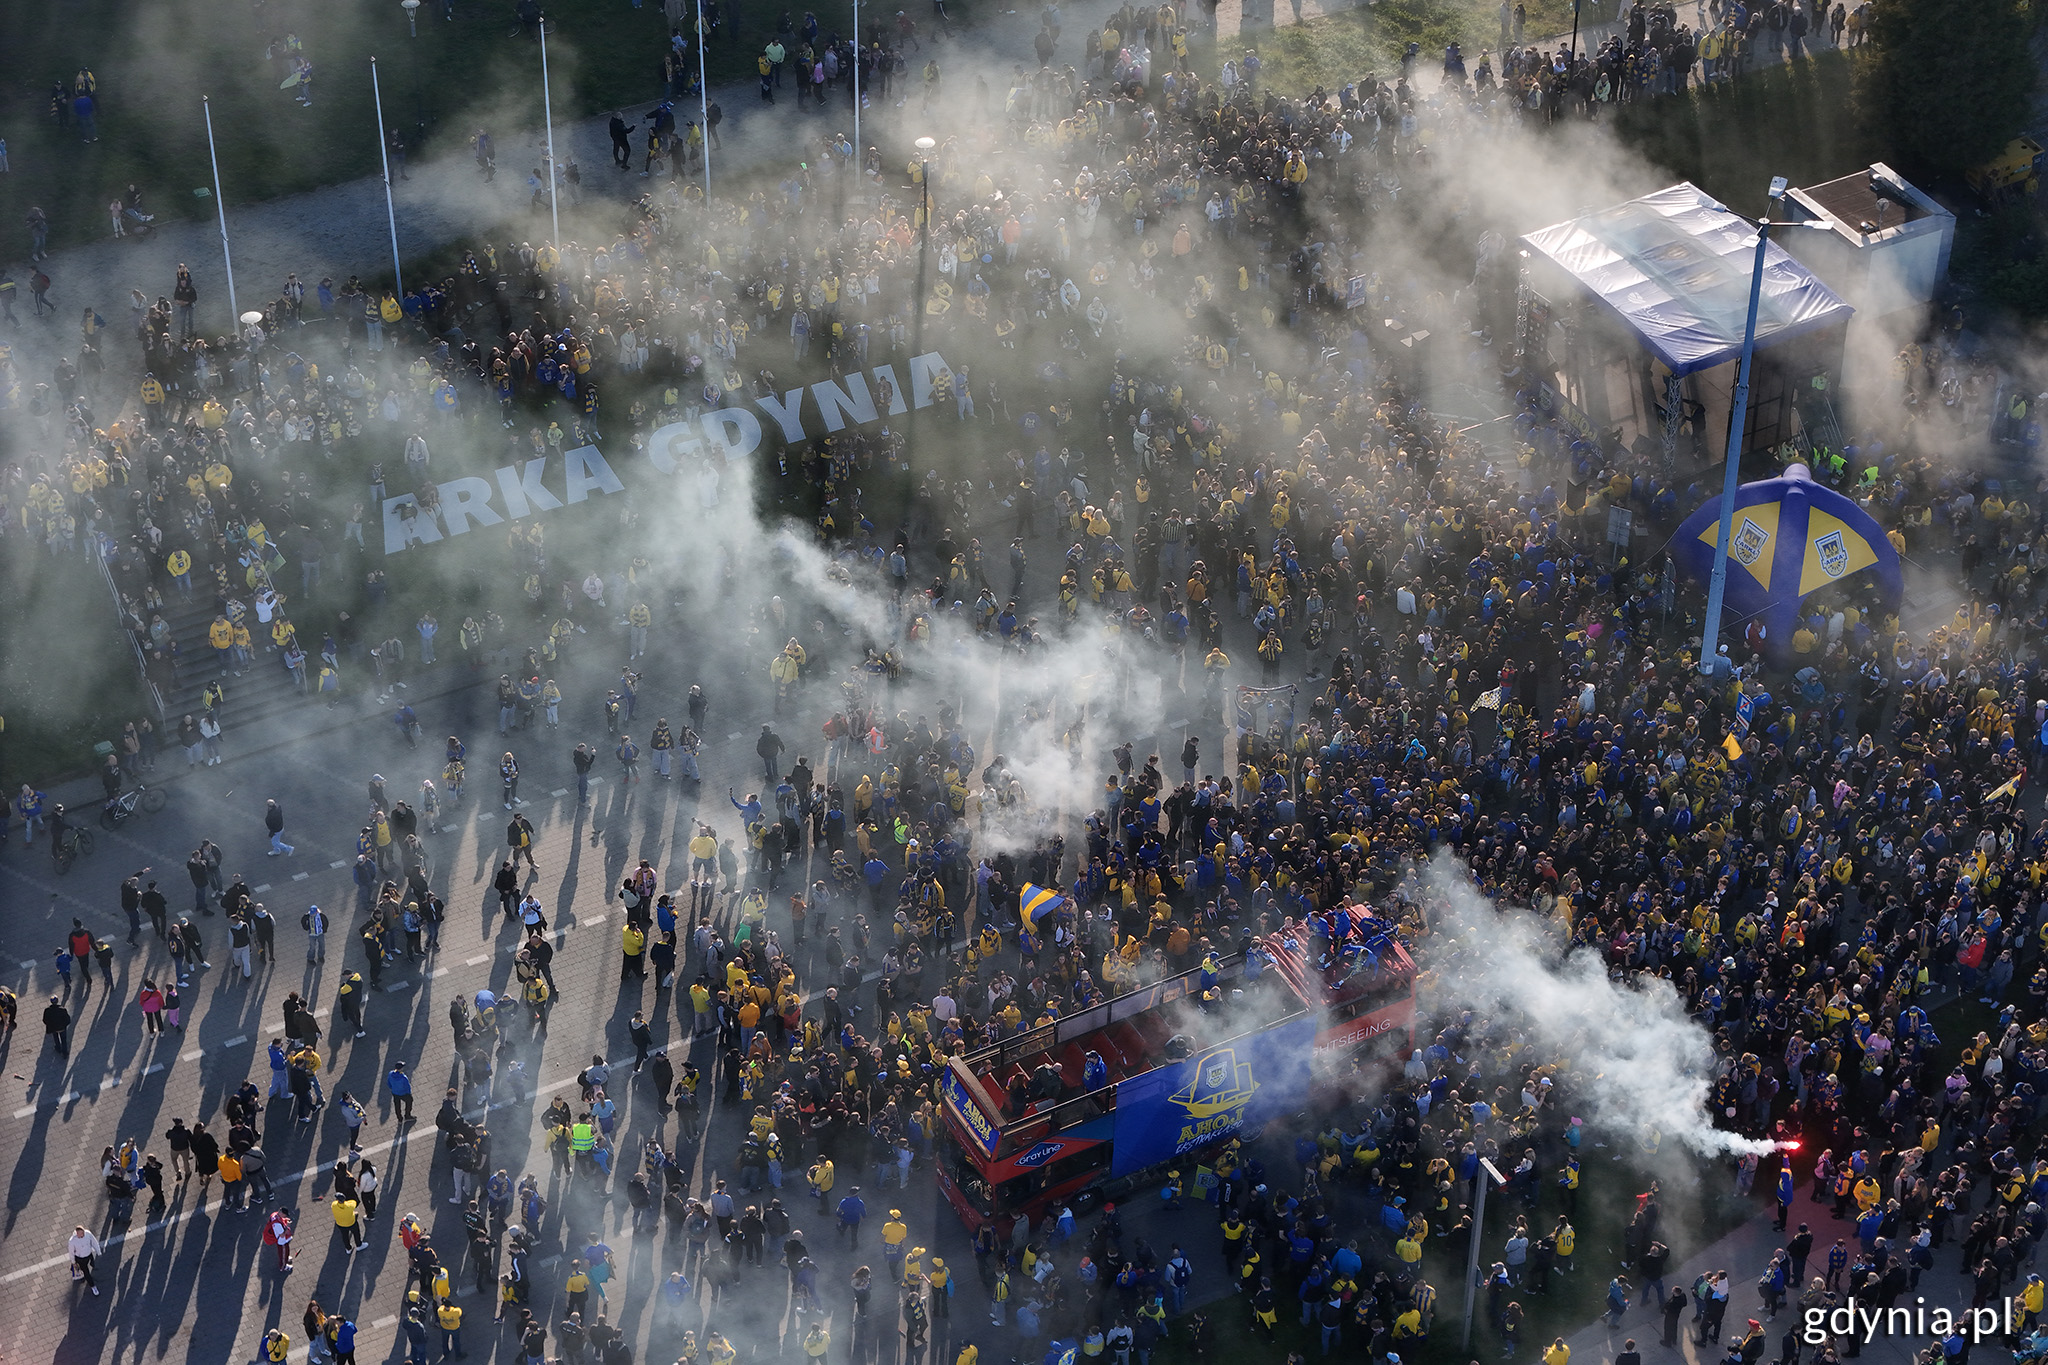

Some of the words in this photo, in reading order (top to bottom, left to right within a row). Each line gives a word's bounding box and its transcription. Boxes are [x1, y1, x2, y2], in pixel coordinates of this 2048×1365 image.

[383, 442, 625, 555] ARKA
[648, 350, 959, 478] GDYNIA
[1739, 541, 1758, 556] ARKA
[1826, 555, 1843, 566] ARKA
[964, 1098, 992, 1136] AHOJ
[1177, 1107, 1245, 1144] AHOJ
[1019, 1151, 1042, 1165] Gray
[1562, 1235, 1572, 1247] 10
